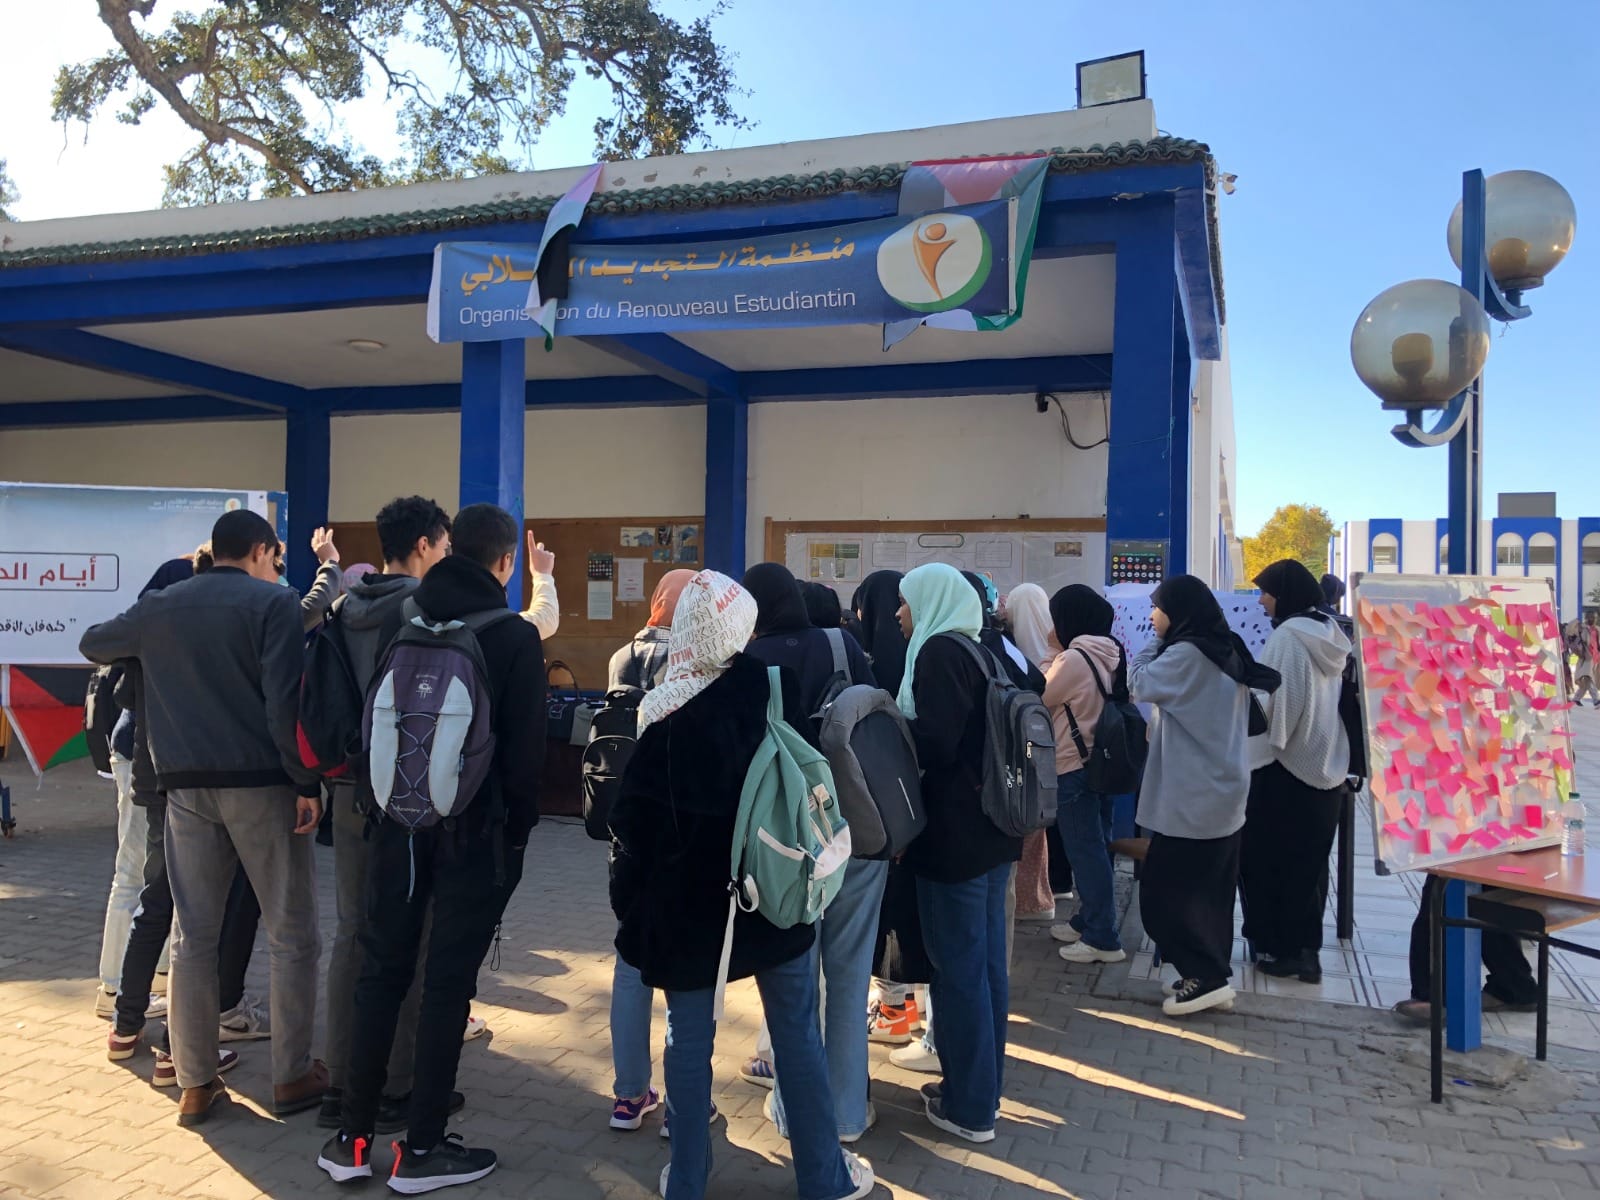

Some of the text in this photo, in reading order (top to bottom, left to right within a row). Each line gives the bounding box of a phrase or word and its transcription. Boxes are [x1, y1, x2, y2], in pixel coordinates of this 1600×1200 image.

[459, 237, 855, 297] منظمة التجديد اللابي
[586, 303, 611, 320] du
[617, 300, 729, 320] Renouveau
[734, 288, 856, 314] Estudiantin
[39, 555, 97, 587] أيام
[714, 583, 741, 614] MAKE
